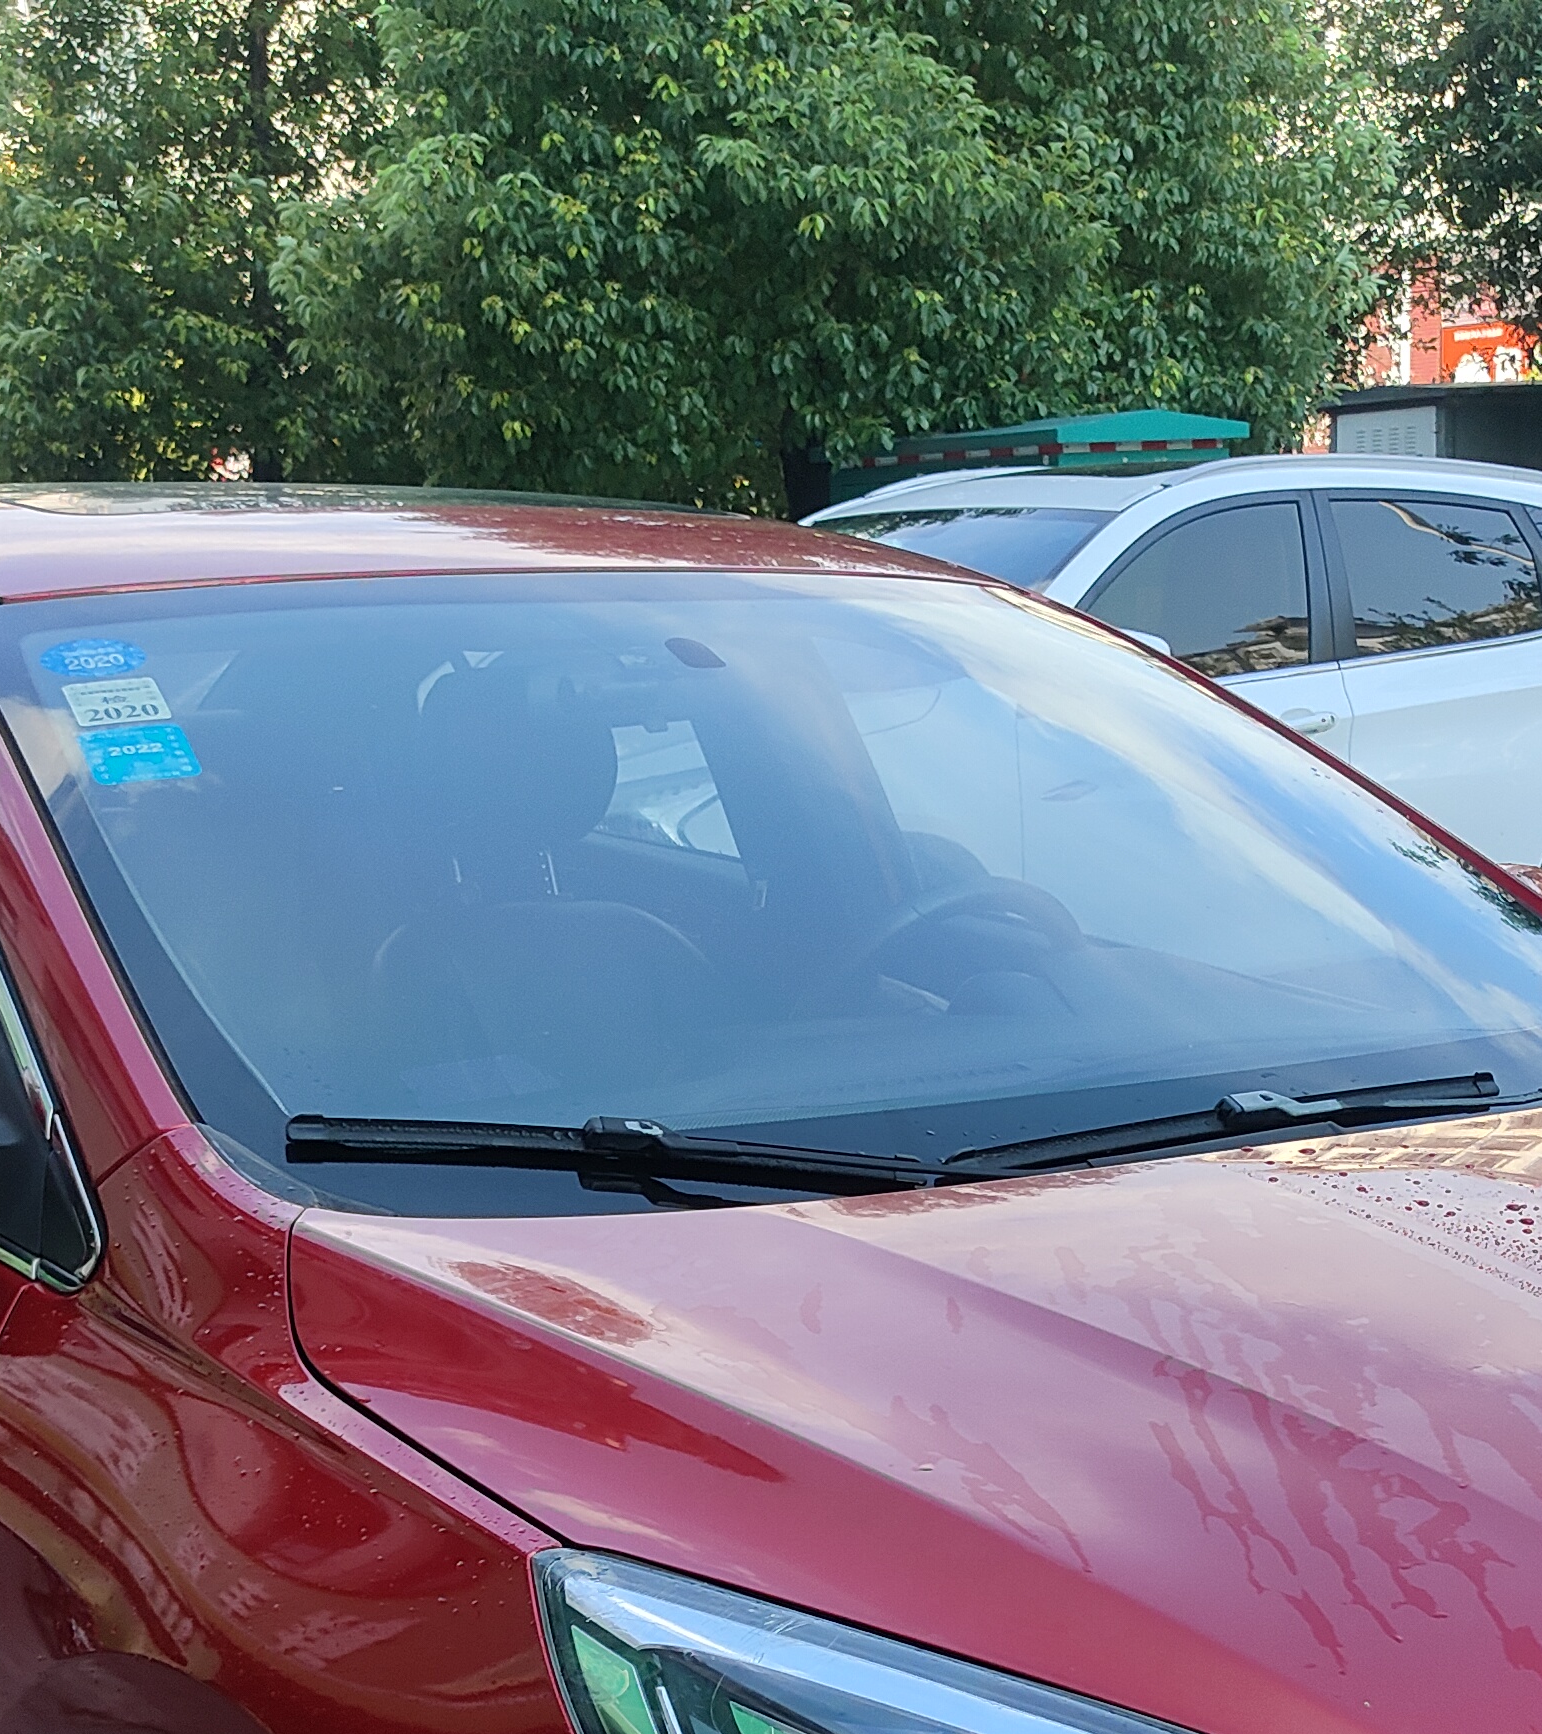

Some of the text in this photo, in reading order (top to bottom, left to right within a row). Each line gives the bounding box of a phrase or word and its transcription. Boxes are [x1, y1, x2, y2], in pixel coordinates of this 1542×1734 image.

[64, 653, 125, 670] 2020
[85, 703, 159, 723] 2020
[109, 743, 164, 757] 2022
